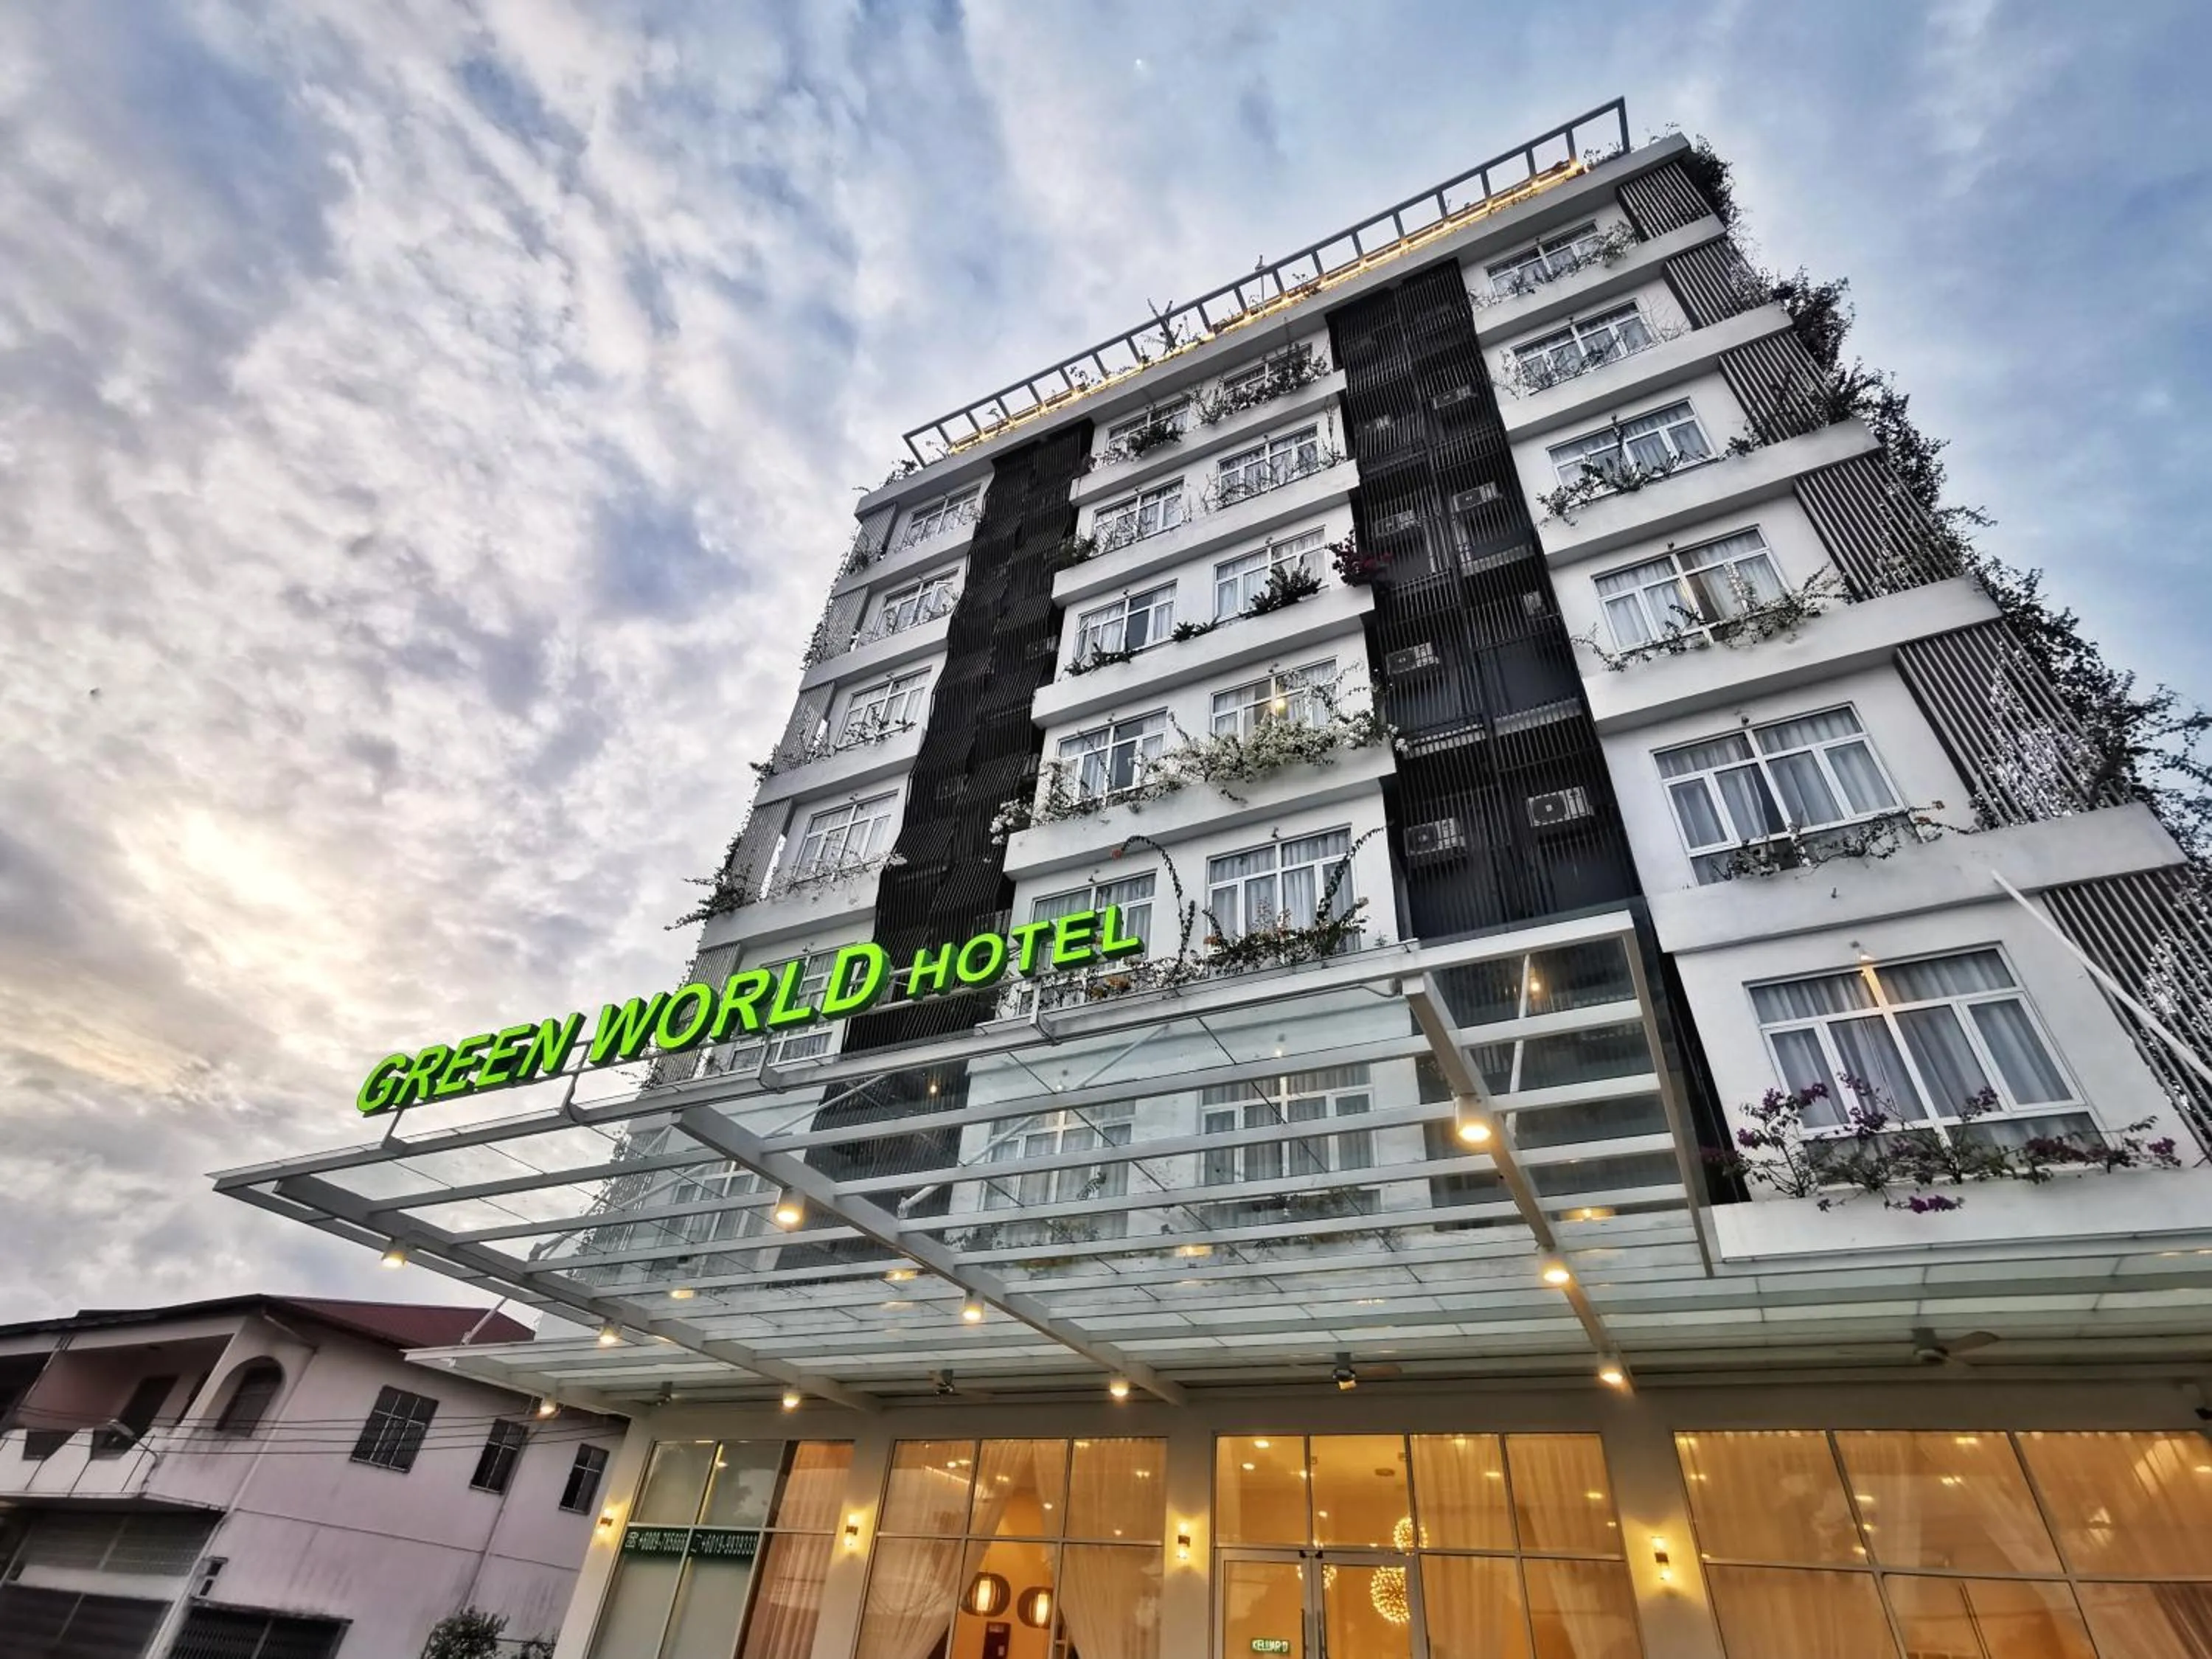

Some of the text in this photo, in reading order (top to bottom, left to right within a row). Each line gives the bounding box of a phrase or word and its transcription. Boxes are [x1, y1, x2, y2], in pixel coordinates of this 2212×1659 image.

[356, 905, 1143, 1114] GREEN WORLD HOTEL
